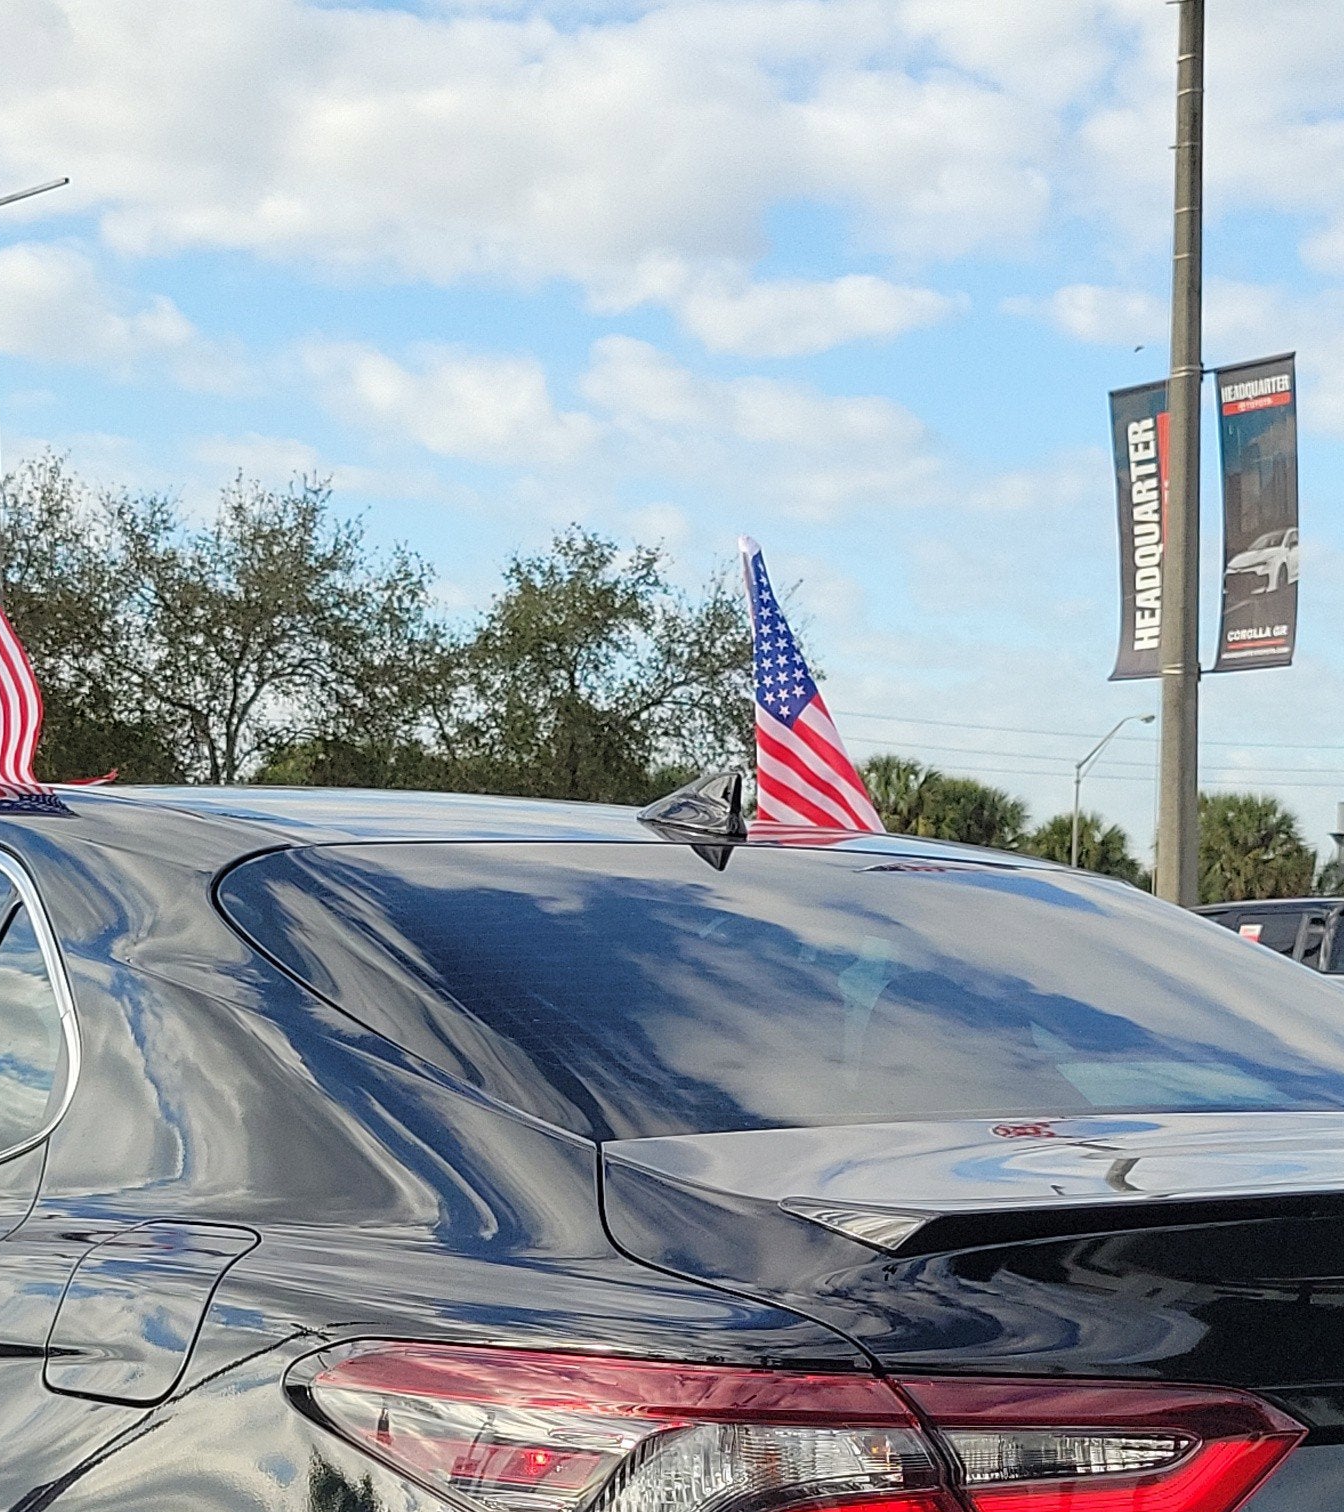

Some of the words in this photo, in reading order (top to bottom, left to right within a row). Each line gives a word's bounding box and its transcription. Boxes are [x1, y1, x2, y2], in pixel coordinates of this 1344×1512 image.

[1221, 374, 1290, 403] HEADQUARTER
[1127, 418, 1163, 651] HEADQUARTER
[1227, 626, 1271, 642] COROLLA
